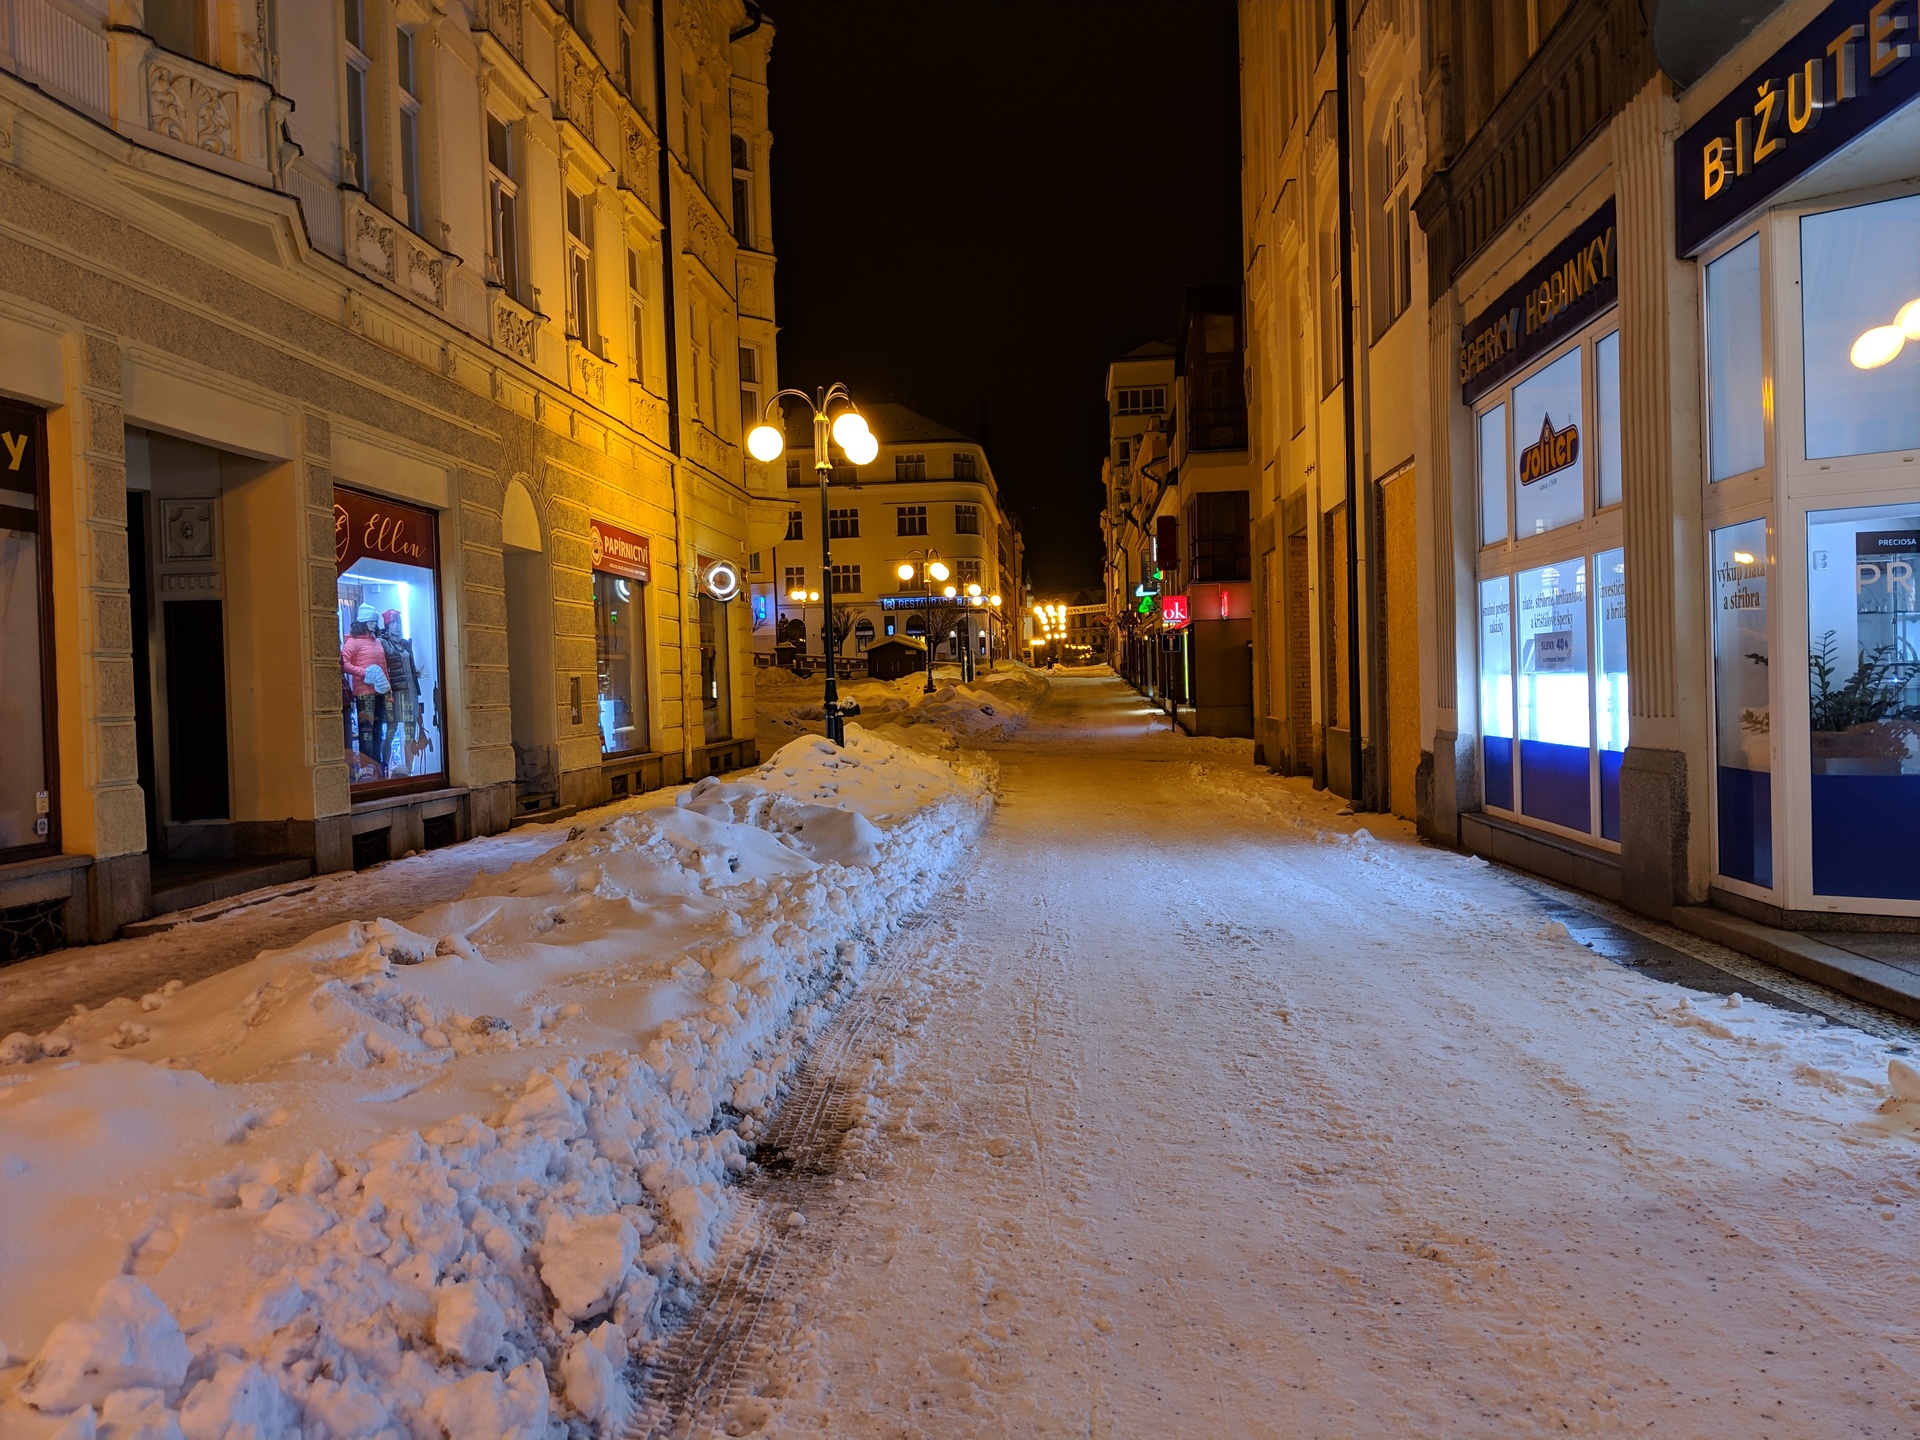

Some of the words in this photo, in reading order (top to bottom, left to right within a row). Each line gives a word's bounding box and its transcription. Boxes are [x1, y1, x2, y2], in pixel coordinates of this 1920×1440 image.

[1704, 0, 1920, 200] BIŽUTE
[1460, 308, 1519, 385] ŠPERKY
[1526, 226, 1616, 335] HODINKY
[364, 513, 427, 558] Ellen
[604, 535, 648, 564] PAPÍRNICTVÍ
[1878, 538, 1917, 546] PRECIOSA
[1717, 561, 1743, 588] výkup
[1856, 562, 1913, 595] PR
[1163, 602, 1187, 620] ok
[1723, 595, 1728, 610] a
[1730, 587, 1760, 610] stříbra
